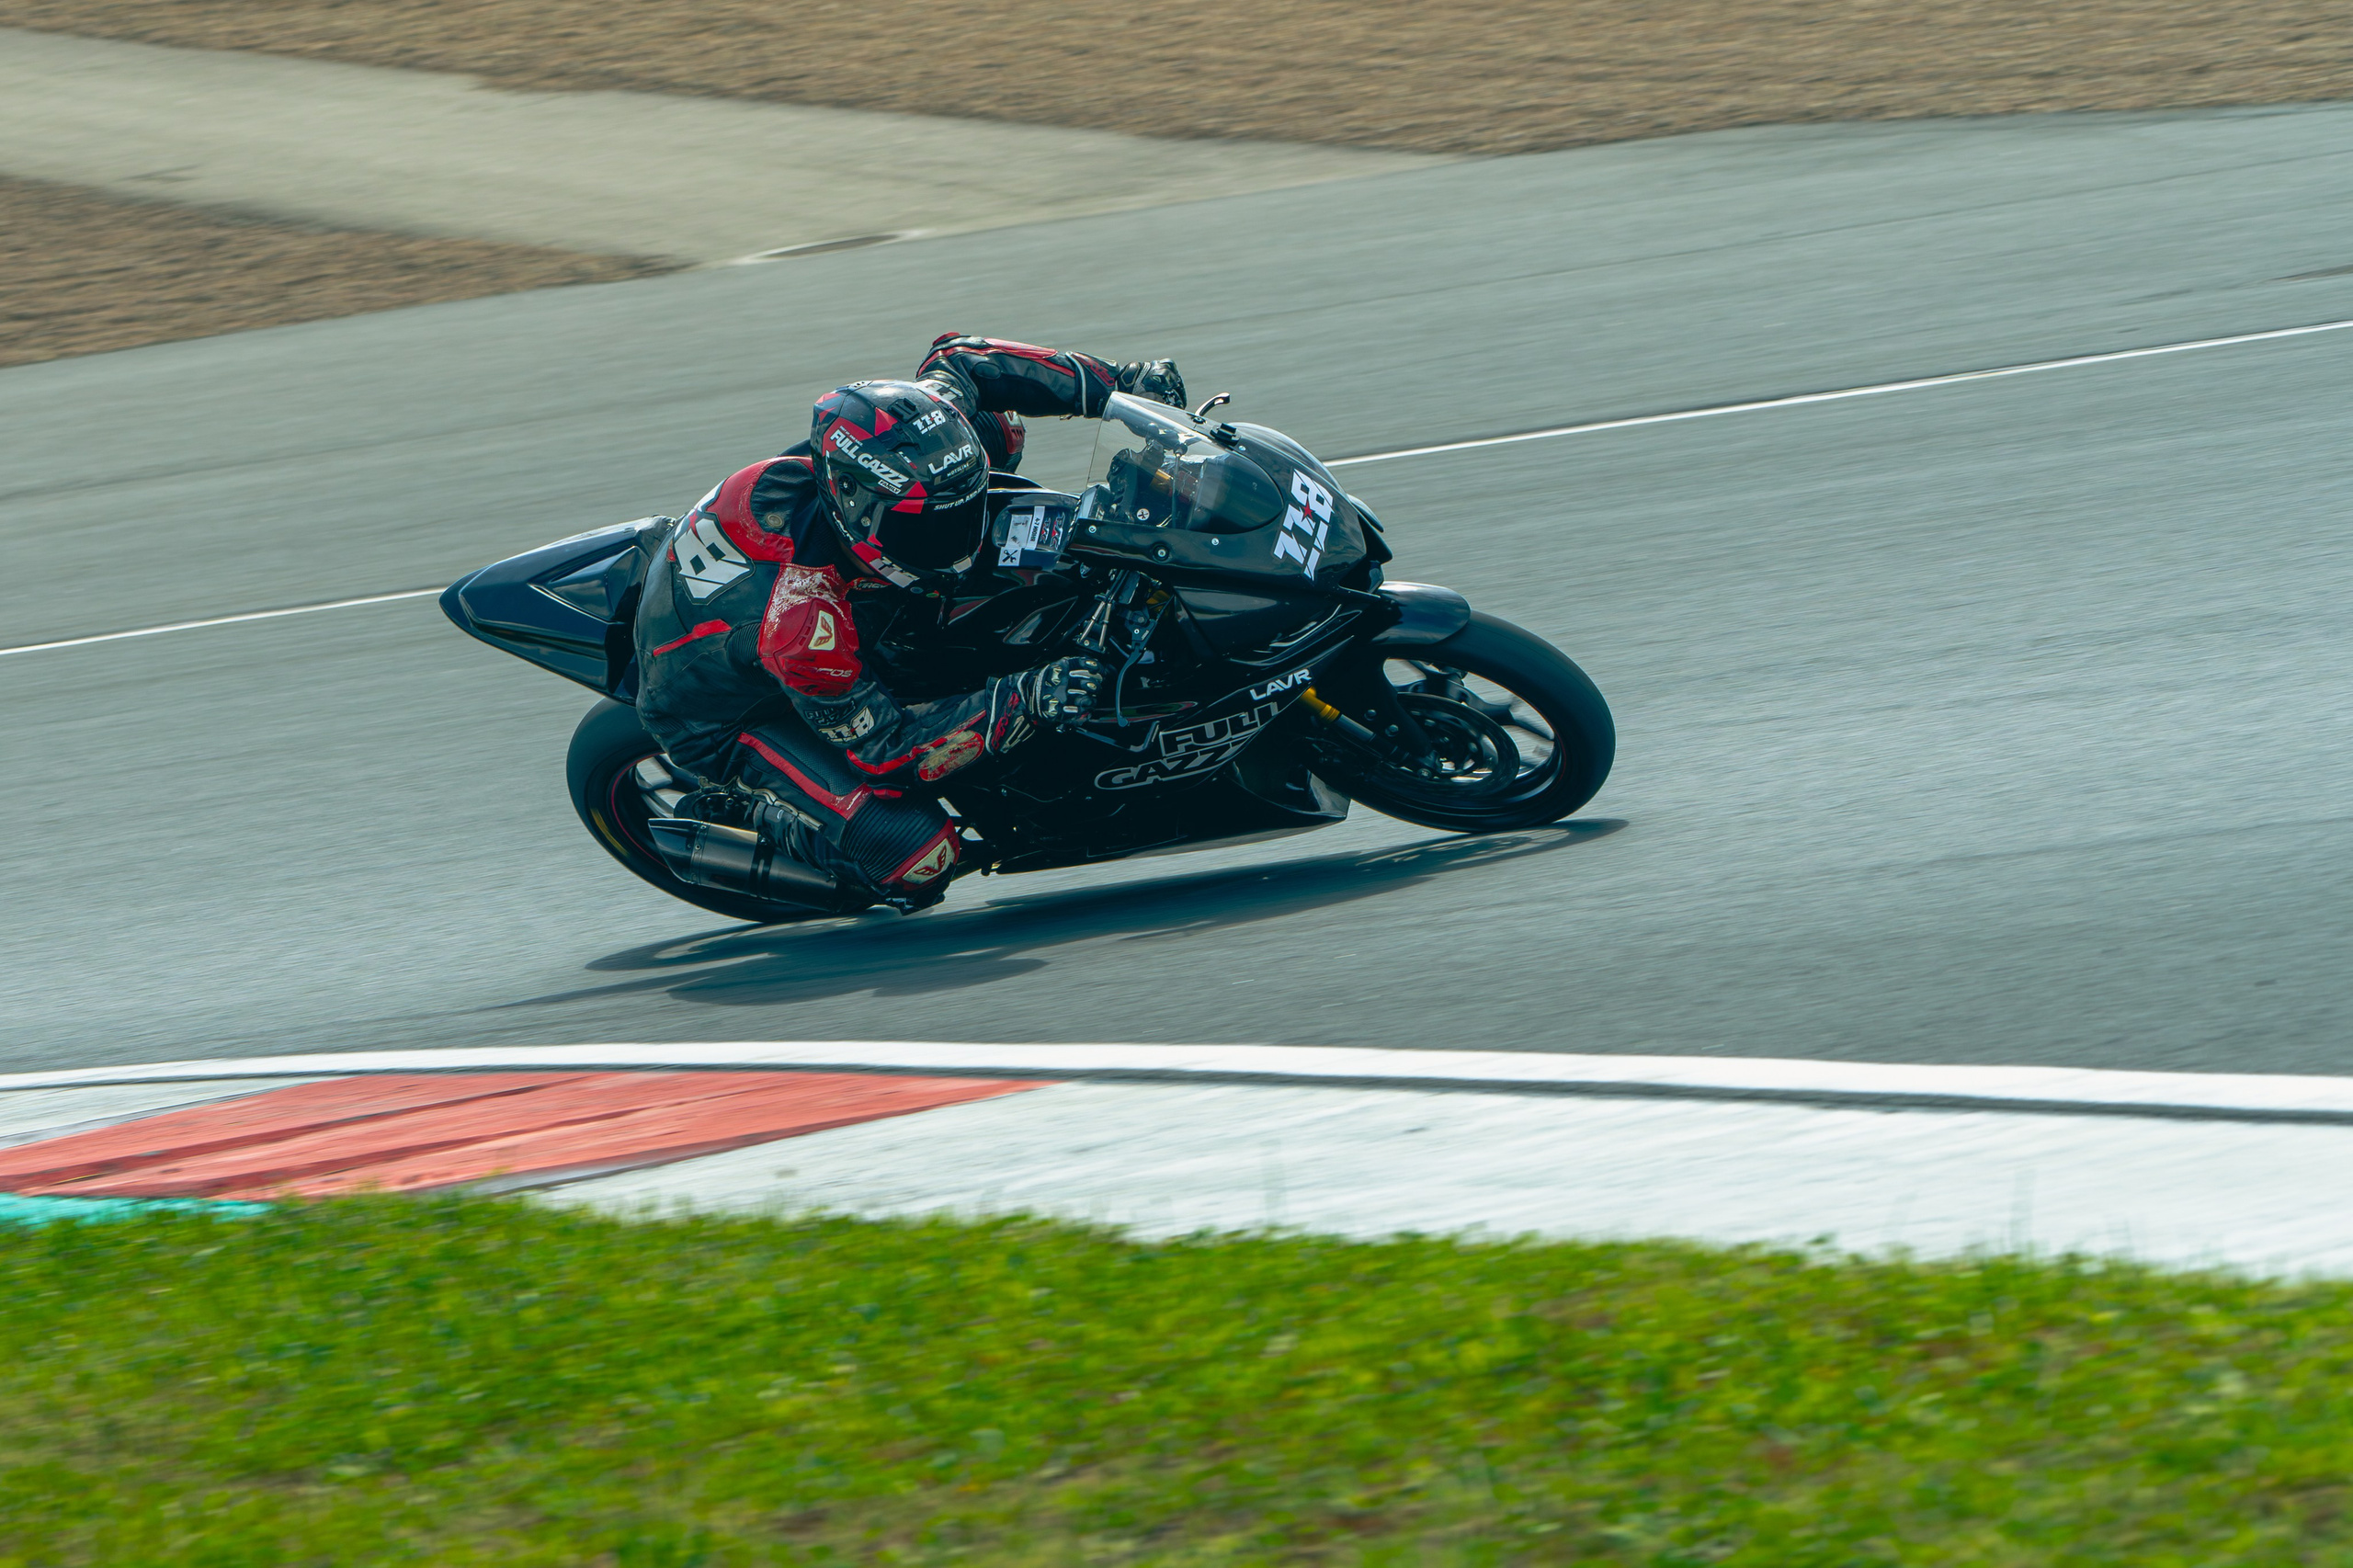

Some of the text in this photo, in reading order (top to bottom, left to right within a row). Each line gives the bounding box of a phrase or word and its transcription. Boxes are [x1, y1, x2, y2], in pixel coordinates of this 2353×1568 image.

[913, 410, 946, 435] 118
[830, 429, 859, 460] FULL
[858, 453, 910, 488] GAZZ
[928, 444, 973, 475] LAVR
[880, 481, 900, 494] FAMILY
[934, 502, 955, 511] SHUT
[1273, 468, 1335, 581] 118
[1249, 668, 1313, 700] LAVR
[1159, 701, 1279, 757] FULL
